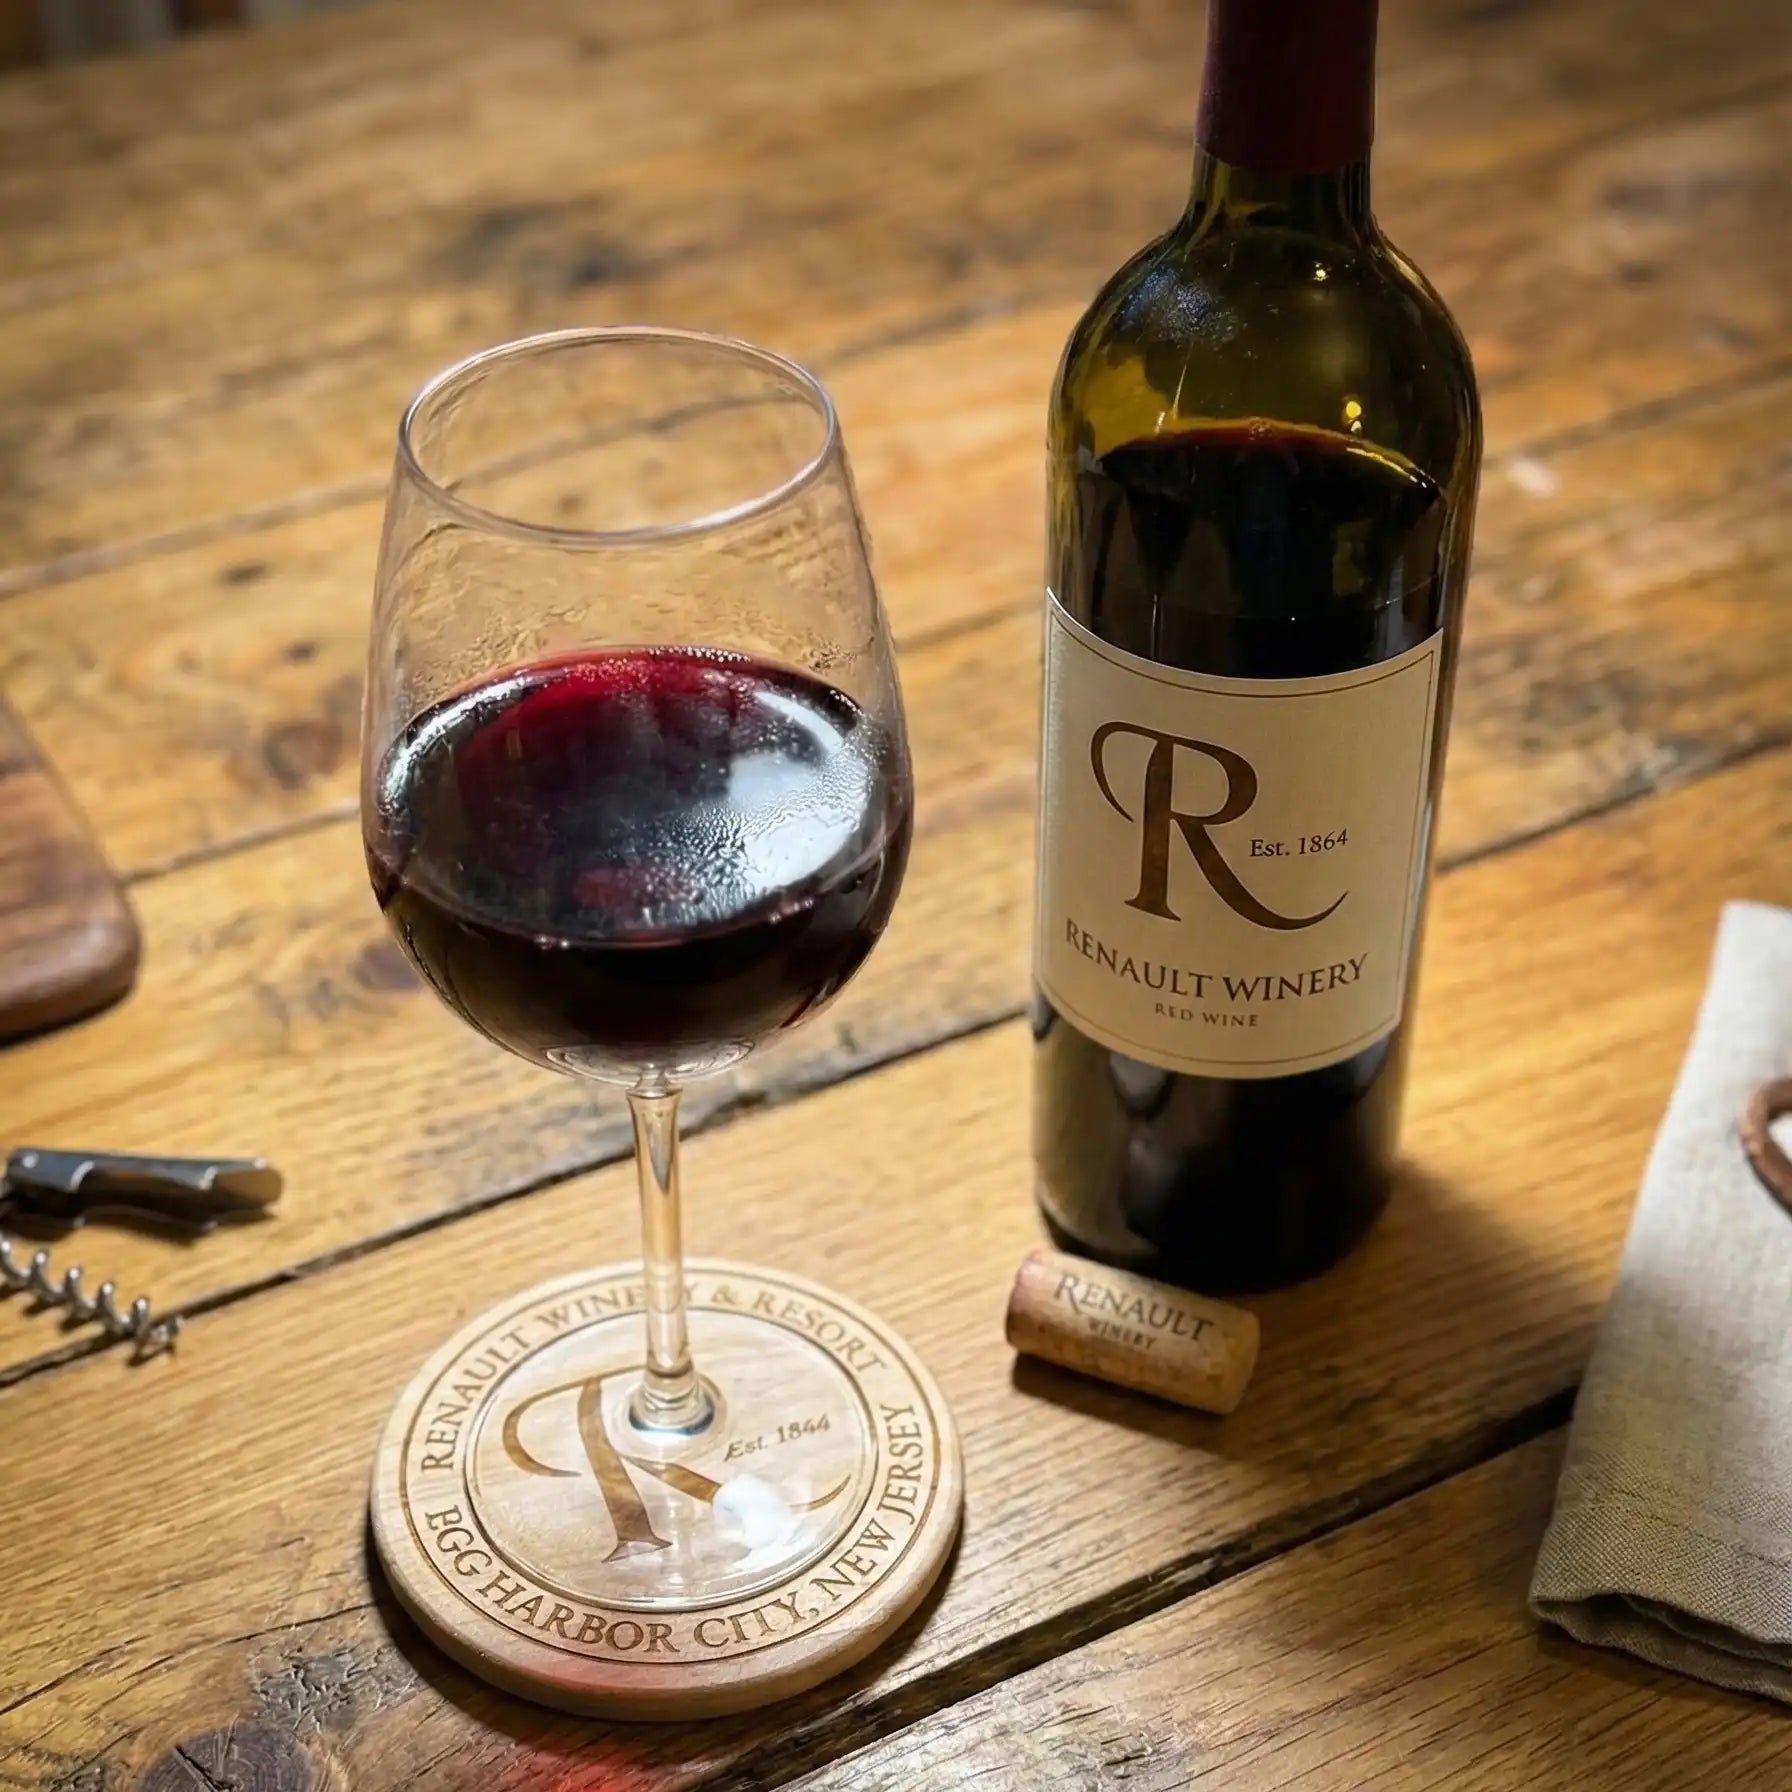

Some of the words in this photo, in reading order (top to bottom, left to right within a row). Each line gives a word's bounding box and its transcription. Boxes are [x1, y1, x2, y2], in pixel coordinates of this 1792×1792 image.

[1090, 721, 1349, 931] R
[1249, 838, 1290, 858] Est.
[1299, 828, 1349, 856] 1864
[1066, 917, 1213, 999] RENAULT
[1223, 952, 1369, 1001] WINERY
[1155, 1002, 1193, 1022] RED
[1203, 1012, 1259, 1028] WINE
[1053, 1272, 1215, 1341] RENAULT
[1088, 1317, 1157, 1350] WINERY
[420, 1326, 532, 1473] RENAULT
[710, 1284, 738, 1306] &
[753, 1289, 888, 1374] RESORT
[724, 1435, 768, 1463] Est.
[424, 1504, 493, 1577] EGG
[475, 1570, 680, 1654] HARBOR
[693, 1591, 820, 1649] CITY,
[809, 1516, 896, 1602] NEW
[875, 1404, 924, 1526] JERSEY
